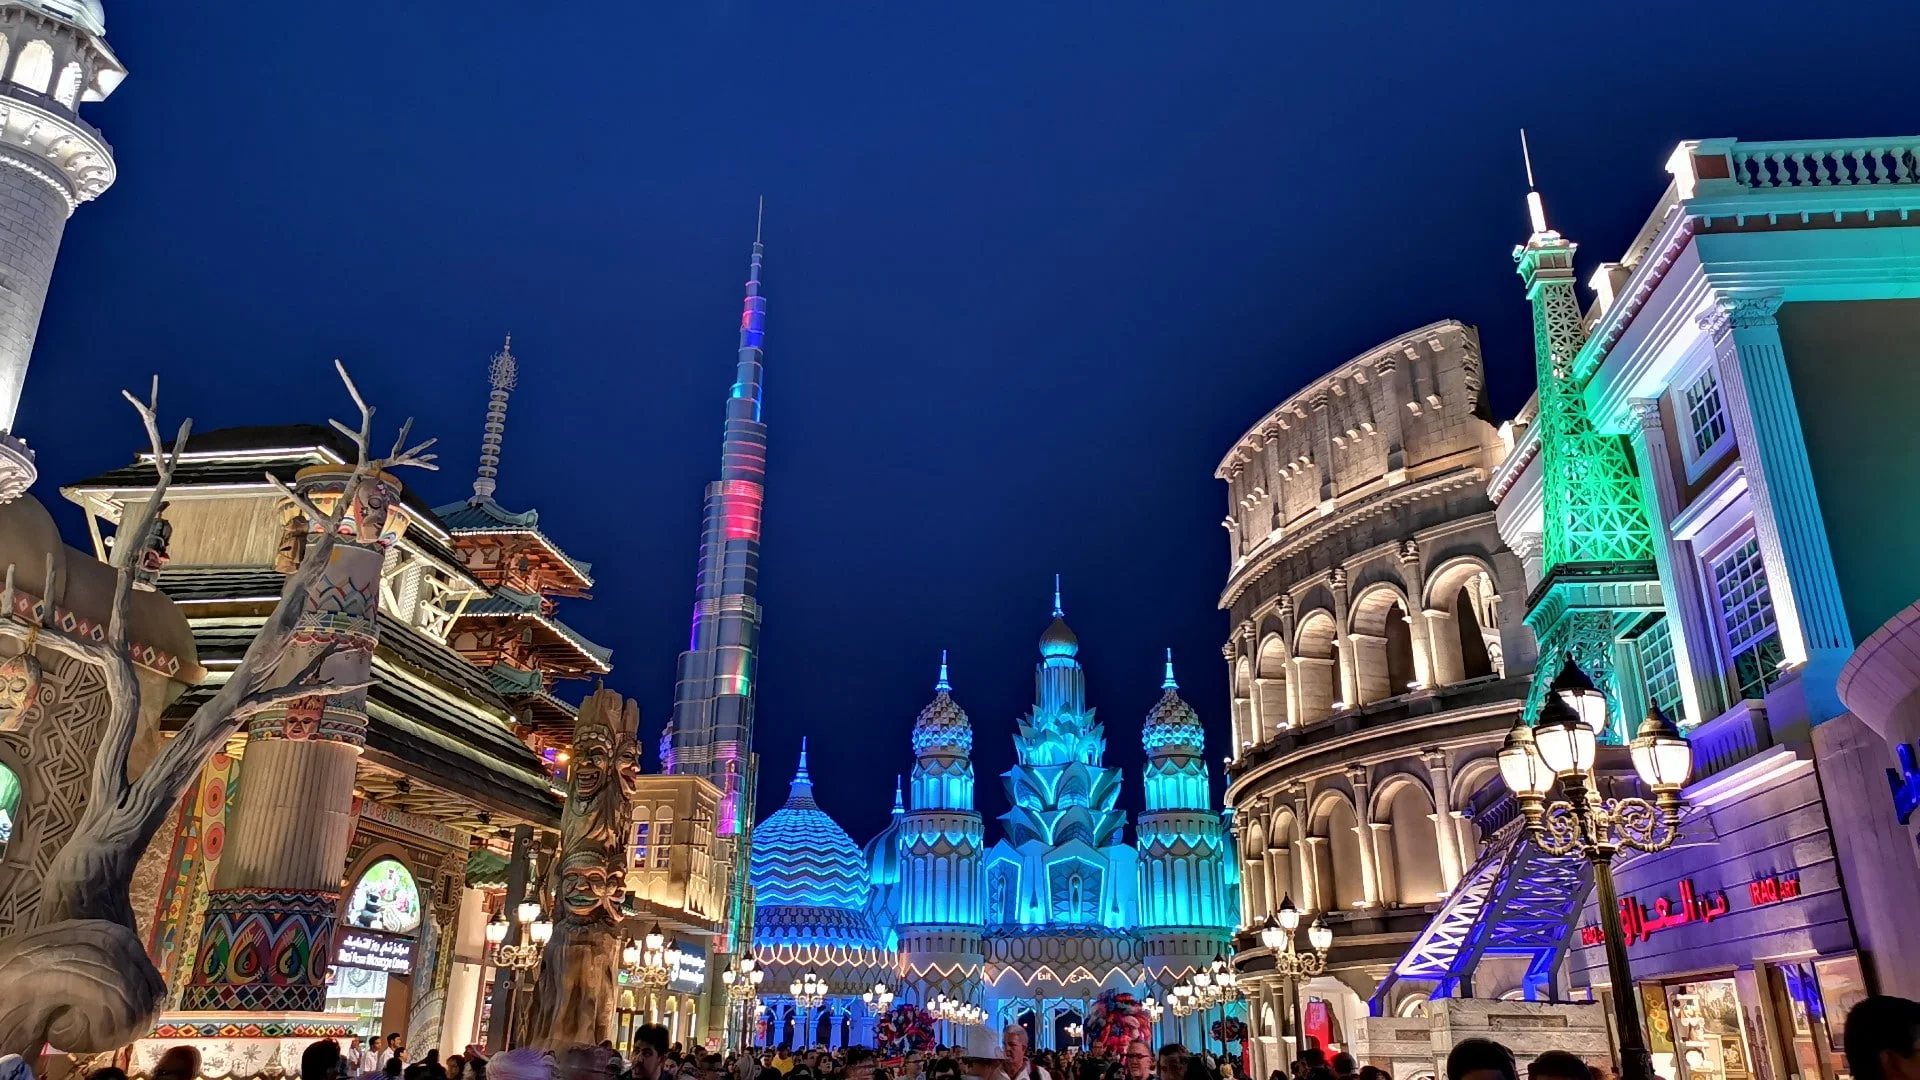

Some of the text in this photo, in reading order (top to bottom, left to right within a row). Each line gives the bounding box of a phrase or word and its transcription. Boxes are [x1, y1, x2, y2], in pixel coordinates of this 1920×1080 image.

[1749, 878, 1798, 905] IRAQ ART
[1619, 878, 1729, 946] فن العراق
[392, 943, 409, 956] مركز
[366, 954, 392, 970] Massage
[1037, 972, 1051, 981] Exit
